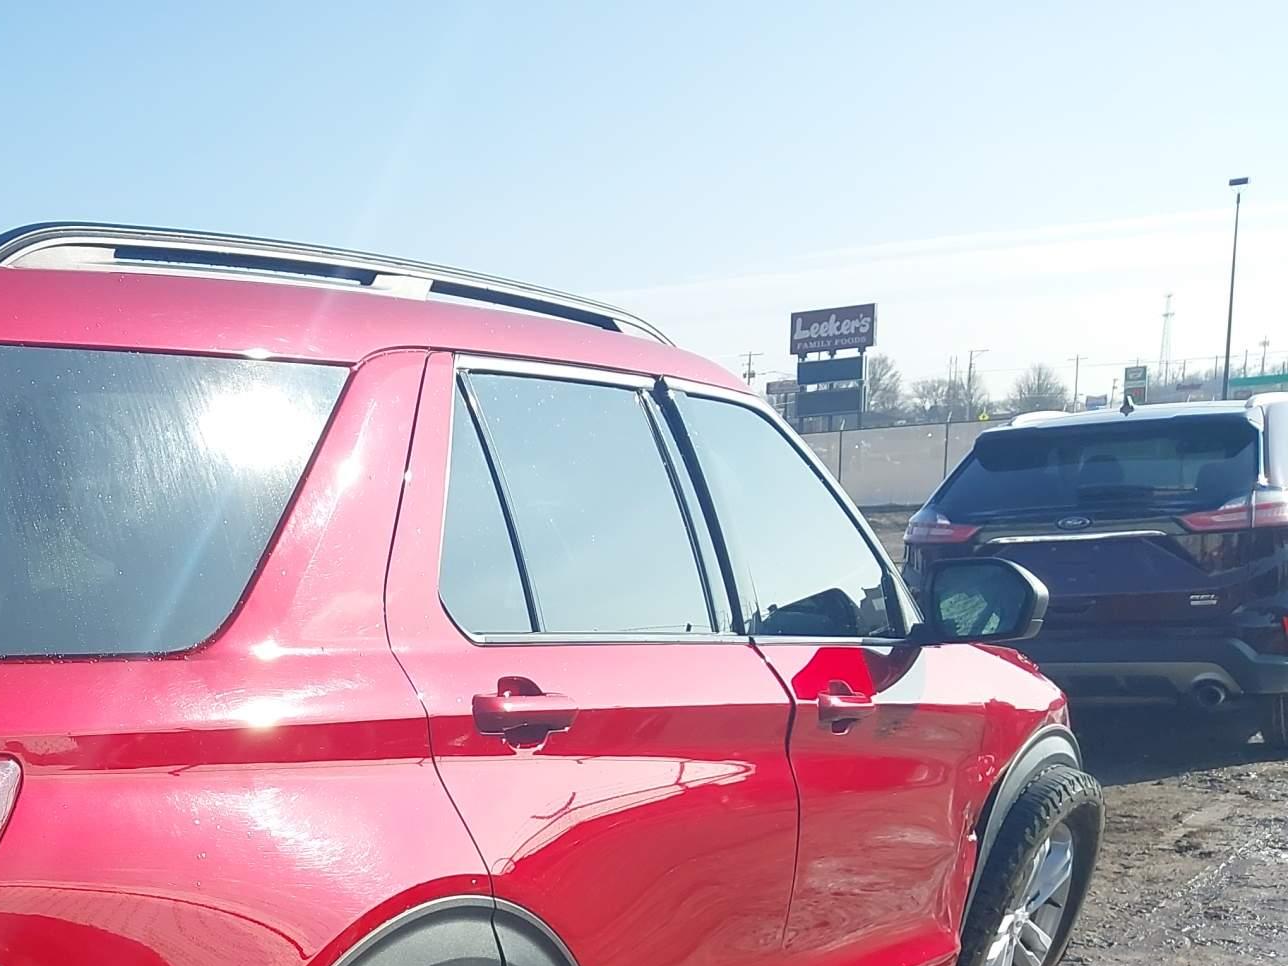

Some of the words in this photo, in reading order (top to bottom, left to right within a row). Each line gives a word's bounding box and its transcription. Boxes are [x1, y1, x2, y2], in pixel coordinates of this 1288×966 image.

[793, 314, 872, 340] Leeker's
[796, 339, 833, 350] FAMILY
[834, 336, 866, 346] FOODS
